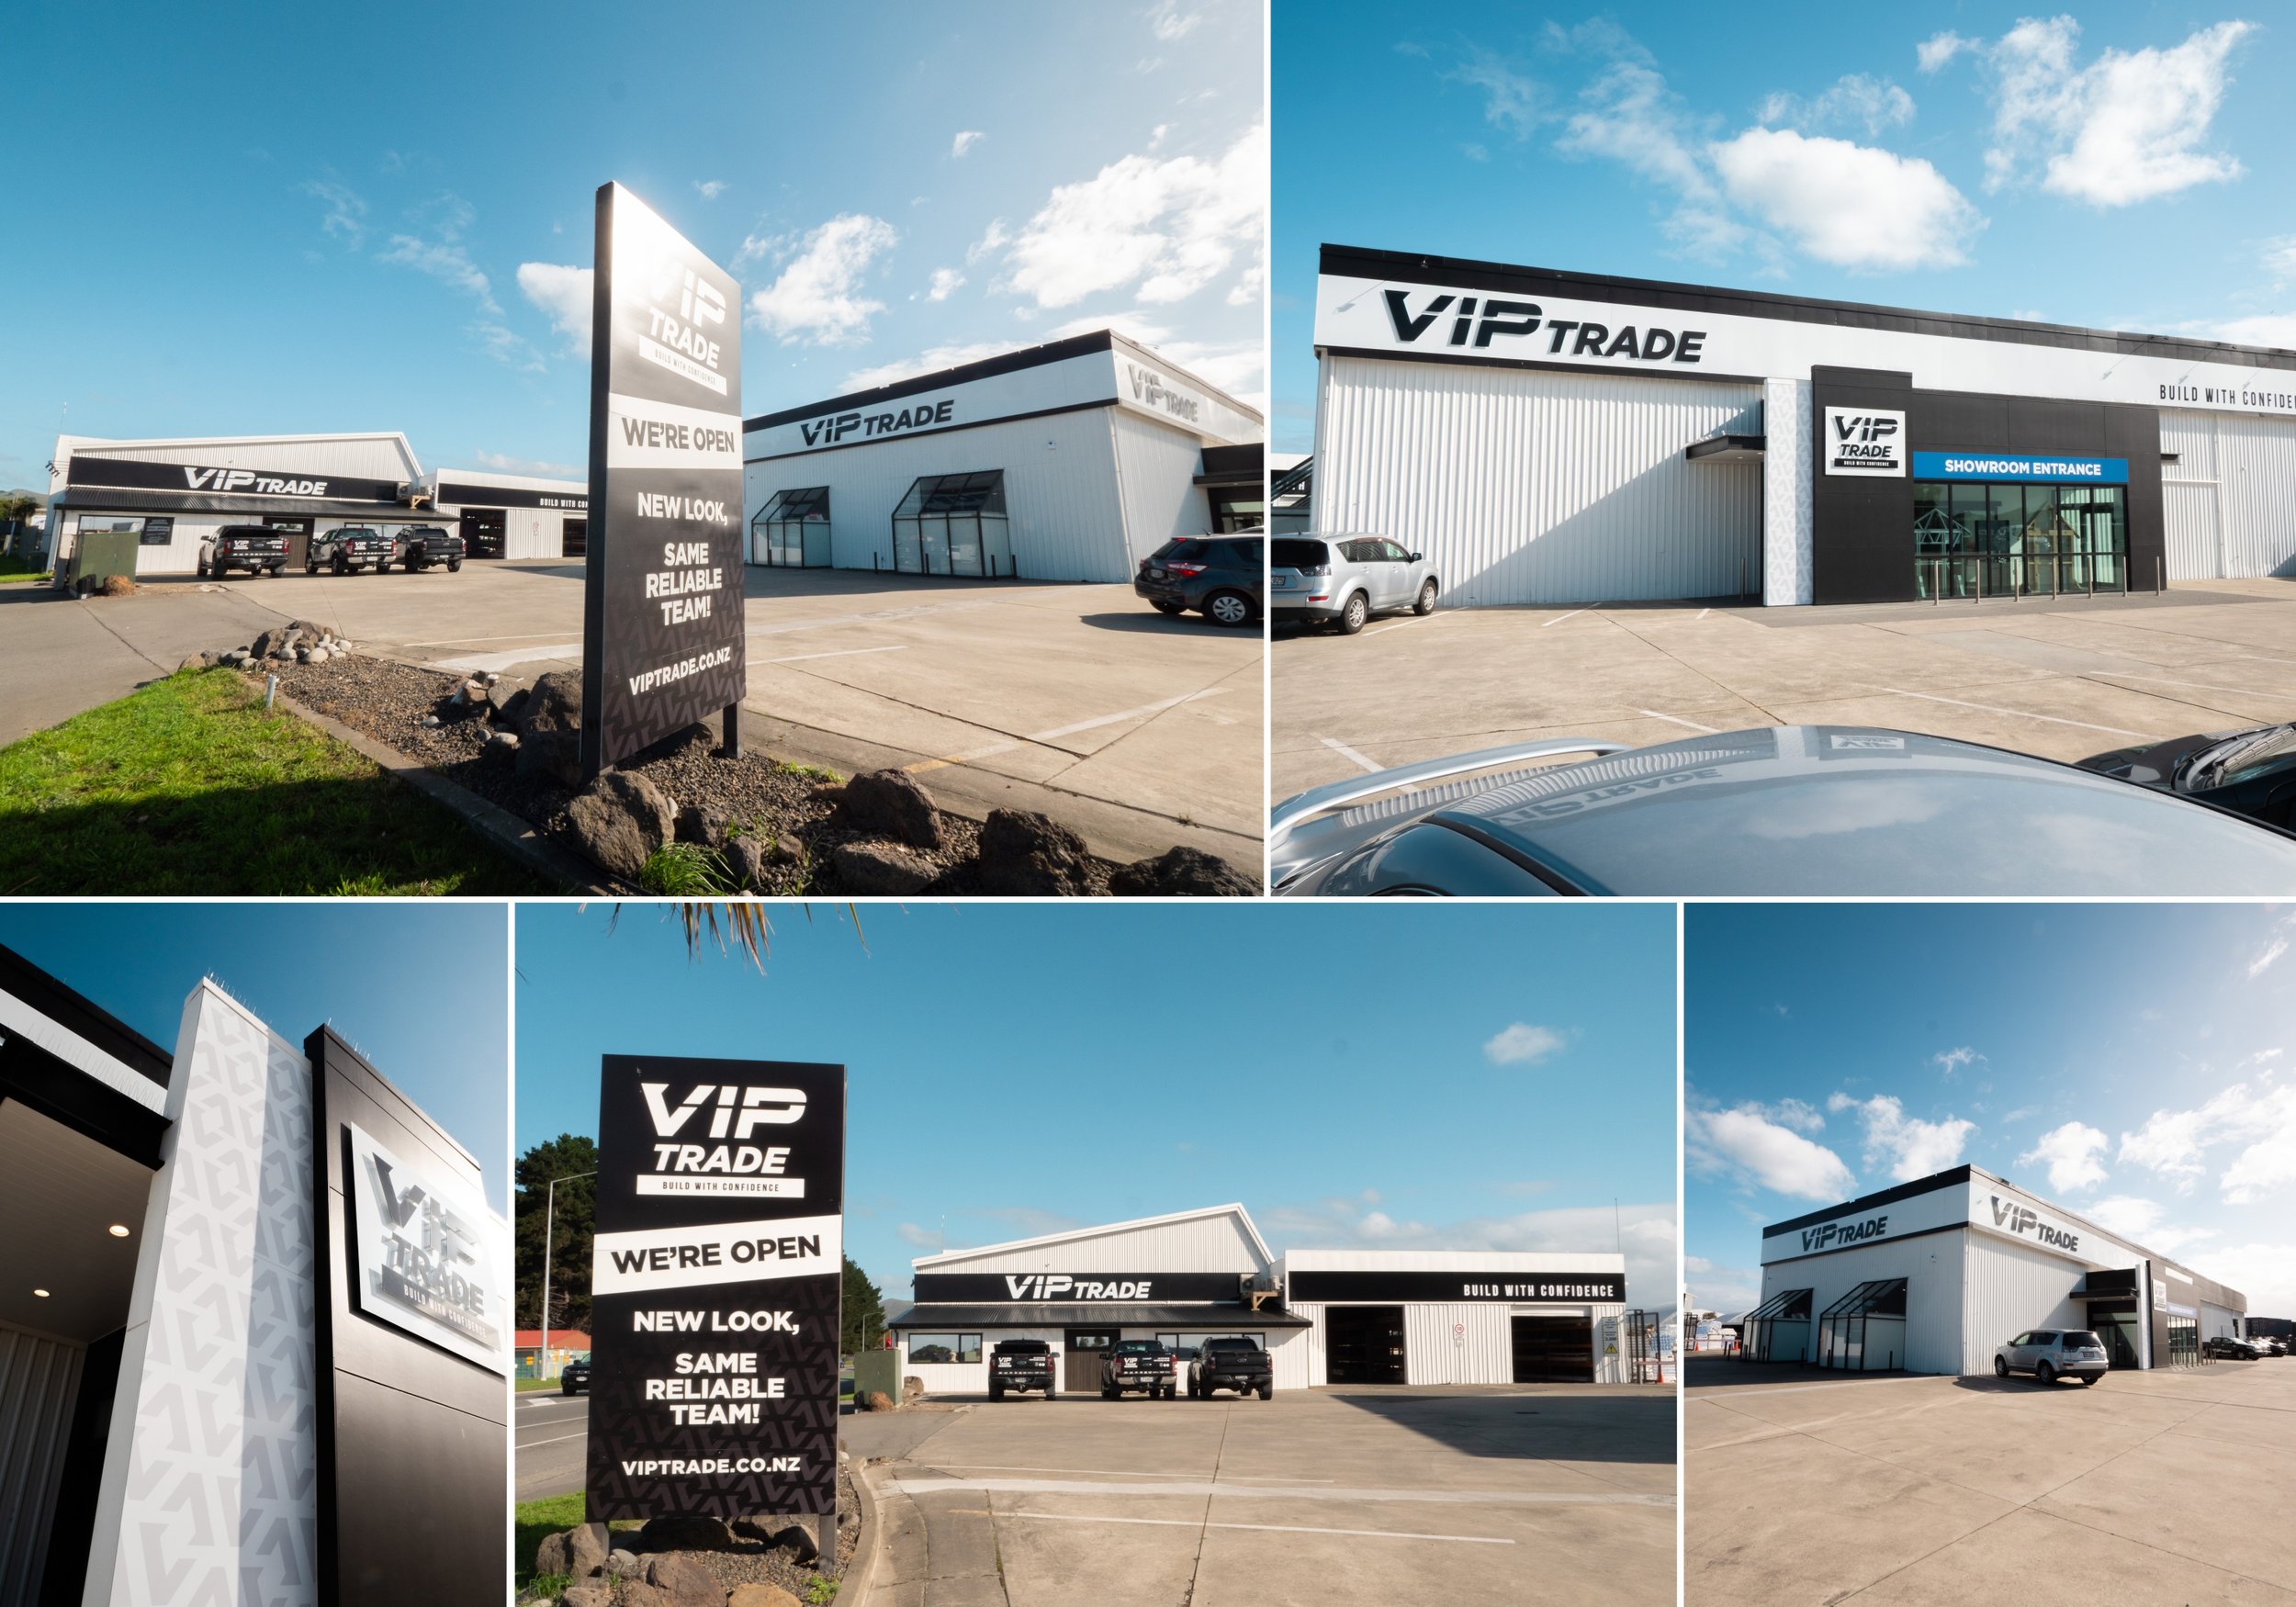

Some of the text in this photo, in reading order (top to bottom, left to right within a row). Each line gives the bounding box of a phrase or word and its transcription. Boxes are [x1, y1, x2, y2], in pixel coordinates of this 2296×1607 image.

[649, 307, 720, 369] TRADE
[1384, 289, 1707, 364] VIP TRADE
[2159, 385, 2296, 410] BUILD WITH CONFIDE
[622, 417, 735, 453] WE'RE OPEN
[801, 399, 954, 446] VIP TRADE
[1834, 415, 1898, 442] VIP
[1840, 444, 1893, 457] TRADE
[184, 466, 328, 496] VIP TRADE
[1944, 459, 2101, 476] SHOWROOM ENTRANCE
[539, 498, 558, 507] BUILD
[560, 499, 576, 508] WITH
[637, 492, 728, 526] NEW LOOK,
[664, 543, 708, 566] SAME
[646, 568, 722, 598] RELIABLE
[660, 596, 711, 625] TEAM!
[629, 646, 731, 695] VIPTRADE.CO.NZ
[641, 1082, 807, 1139] VIP
[653, 1143, 791, 1174] TRADE
[662, 1181, 780, 1192] BUILD WITH CONFIDENCE
[1801, 1216, 1888, 1252] VIP TRADE
[1991, 1195, 2079, 1252] VIP TRADE
[611, 1234, 821, 1275] WE'RE OPEN
[392, 1231, 484, 1317] TRADE
[1005, 1275, 1152, 1299] VIP TRADE
[1463, 1284, 1614, 1298] BUILD WITH CONFIDENCE
[403, 1284, 488, 1339] BUILD WITH CONFIDENCE
[634, 1310, 800, 1335] NEW LOOK,
[674, 1352, 758, 1374] SAME
[646, 1377, 785, 1400] RELIABLE
[670, 1403, 760, 1425] TEAM!
[622, 1457, 801, 1476] VIPTRADE.CO.NZ
